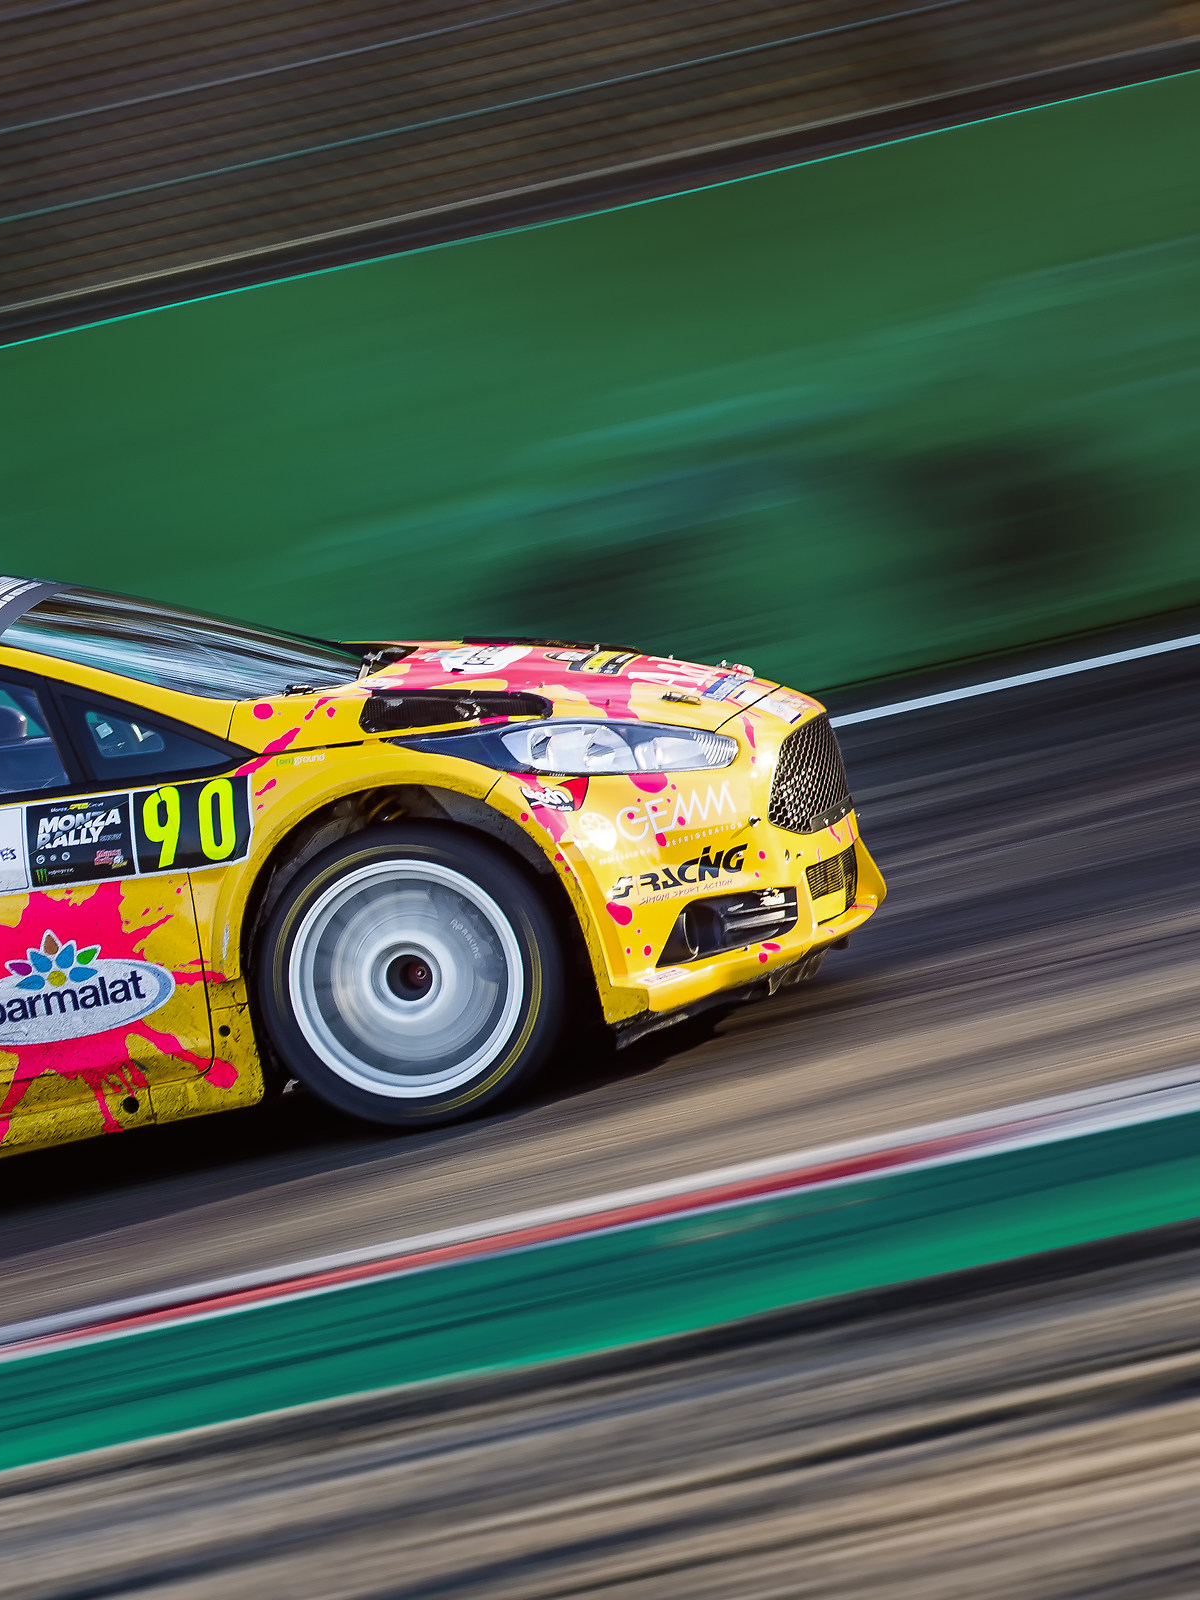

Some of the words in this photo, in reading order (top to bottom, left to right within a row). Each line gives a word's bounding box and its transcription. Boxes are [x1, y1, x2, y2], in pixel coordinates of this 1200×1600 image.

[38, 808, 121, 833] MONZA
[142, 778, 236, 868] 90
[616, 781, 736, 841] GEMM
[36, 826, 104, 850] RALLY
[672, 886, 700, 898] SPORT
[703, 878, 733, 890] ACTION
